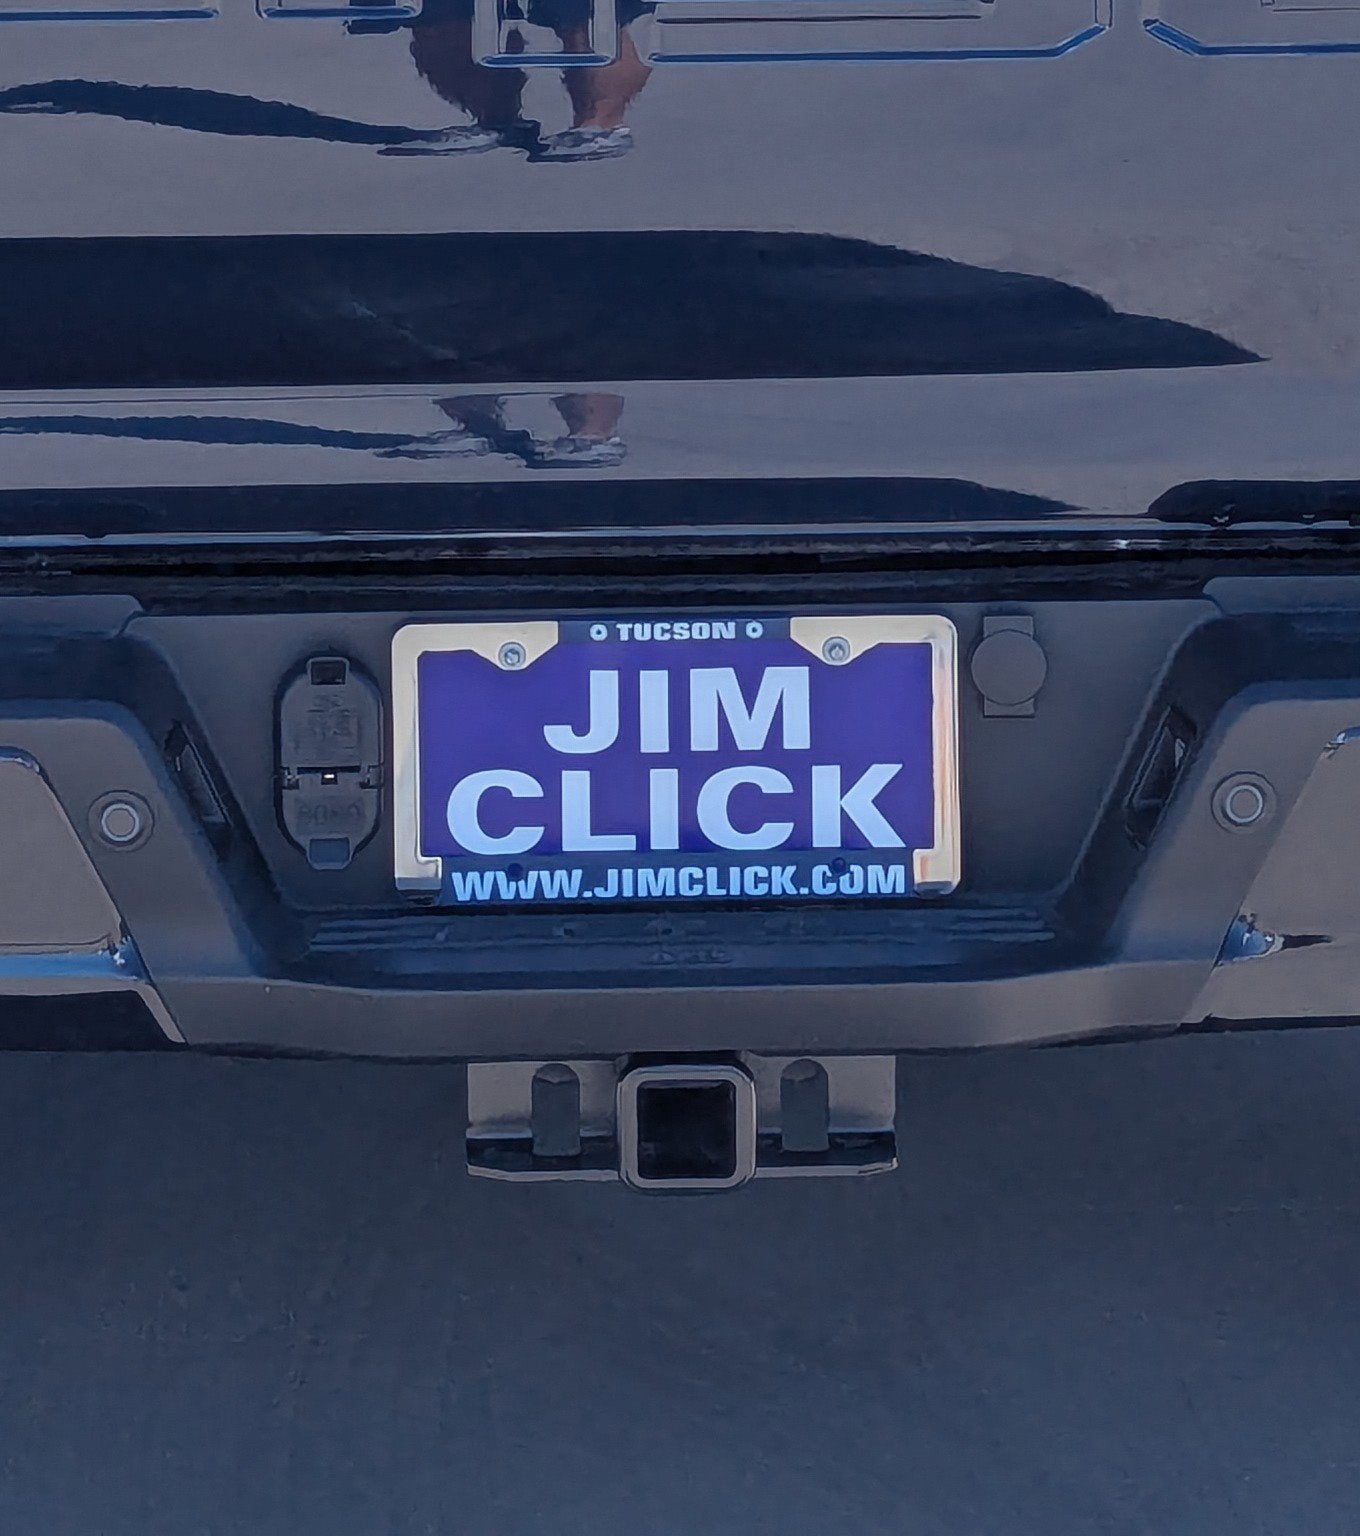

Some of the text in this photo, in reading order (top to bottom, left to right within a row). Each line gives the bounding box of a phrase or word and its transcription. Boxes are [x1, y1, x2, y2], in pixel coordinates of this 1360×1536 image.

[616, 621, 736, 642] TUCSON
[543, 666, 811, 754] JIM
[446, 764, 907, 855] CLICK
[451, 864, 906, 902] WWW.JIMCLICK.COM
